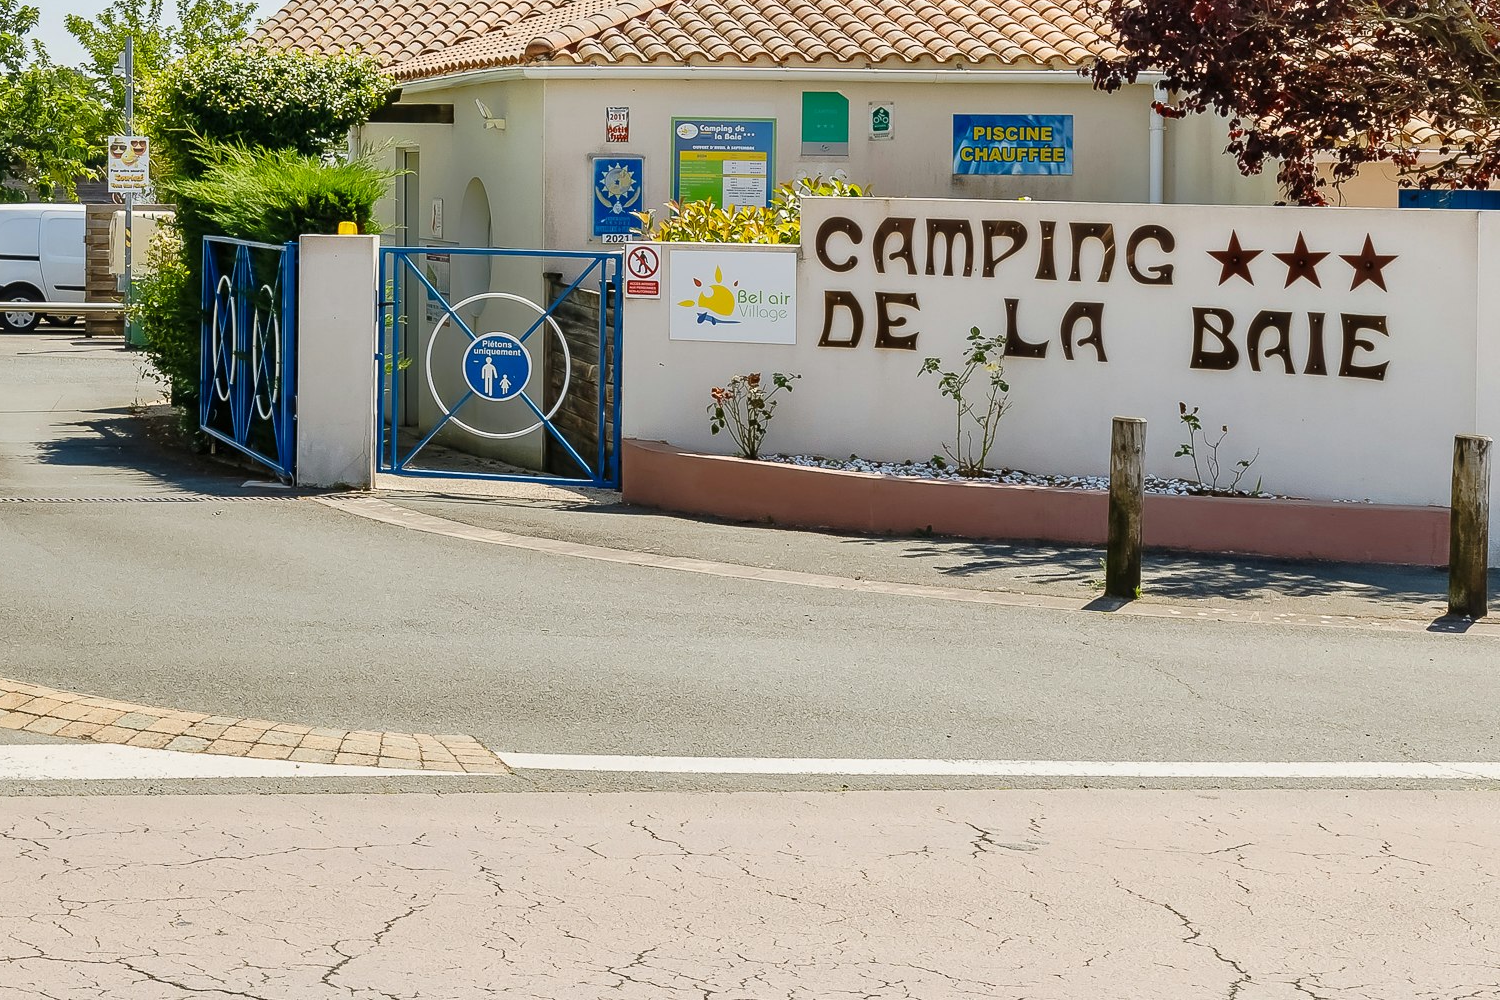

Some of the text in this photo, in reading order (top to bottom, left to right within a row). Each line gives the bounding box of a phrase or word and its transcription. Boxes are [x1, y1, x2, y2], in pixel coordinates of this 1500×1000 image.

[699, 124, 733, 133] Camping
[973, 126, 1053, 141] PISCINE
[960, 144, 1065, 162] CHAUFFÉE
[606, 234, 629, 243] 2021
[815, 216, 1175, 286] CAMPING
[737, 289, 791, 305] Bel air
[738, 304, 788, 322] Village
[817, 290, 1391, 382] DE LA BAIE
[482, 340, 513, 348] Piétons
[473, 348, 521, 357] uniquement
